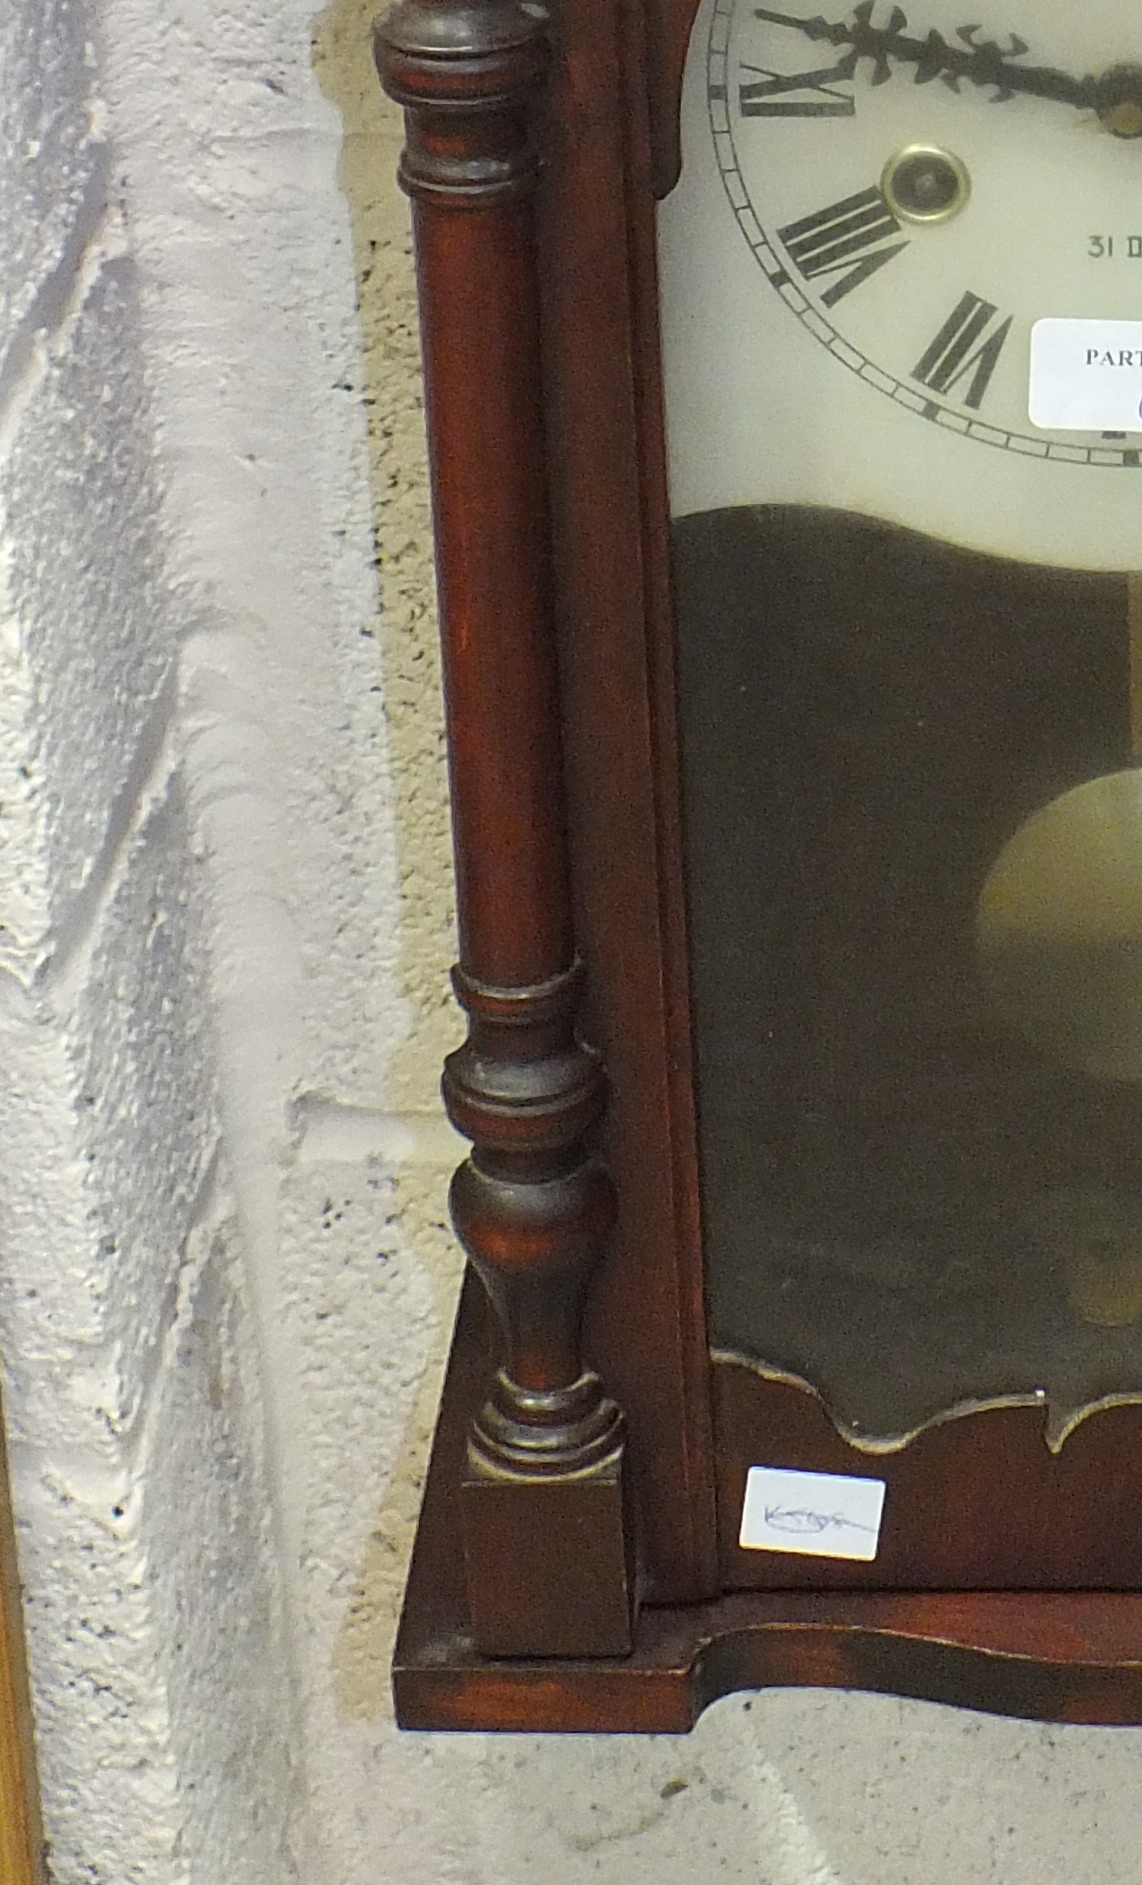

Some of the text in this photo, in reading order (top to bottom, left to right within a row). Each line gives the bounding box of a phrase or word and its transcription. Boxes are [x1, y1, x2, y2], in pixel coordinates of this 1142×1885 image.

[739, 53, 856, 117] IX
[776, 184, 912, 309] VIII
[1087, 235, 1113, 258] 31
[910, 290, 1014, 410] VII
